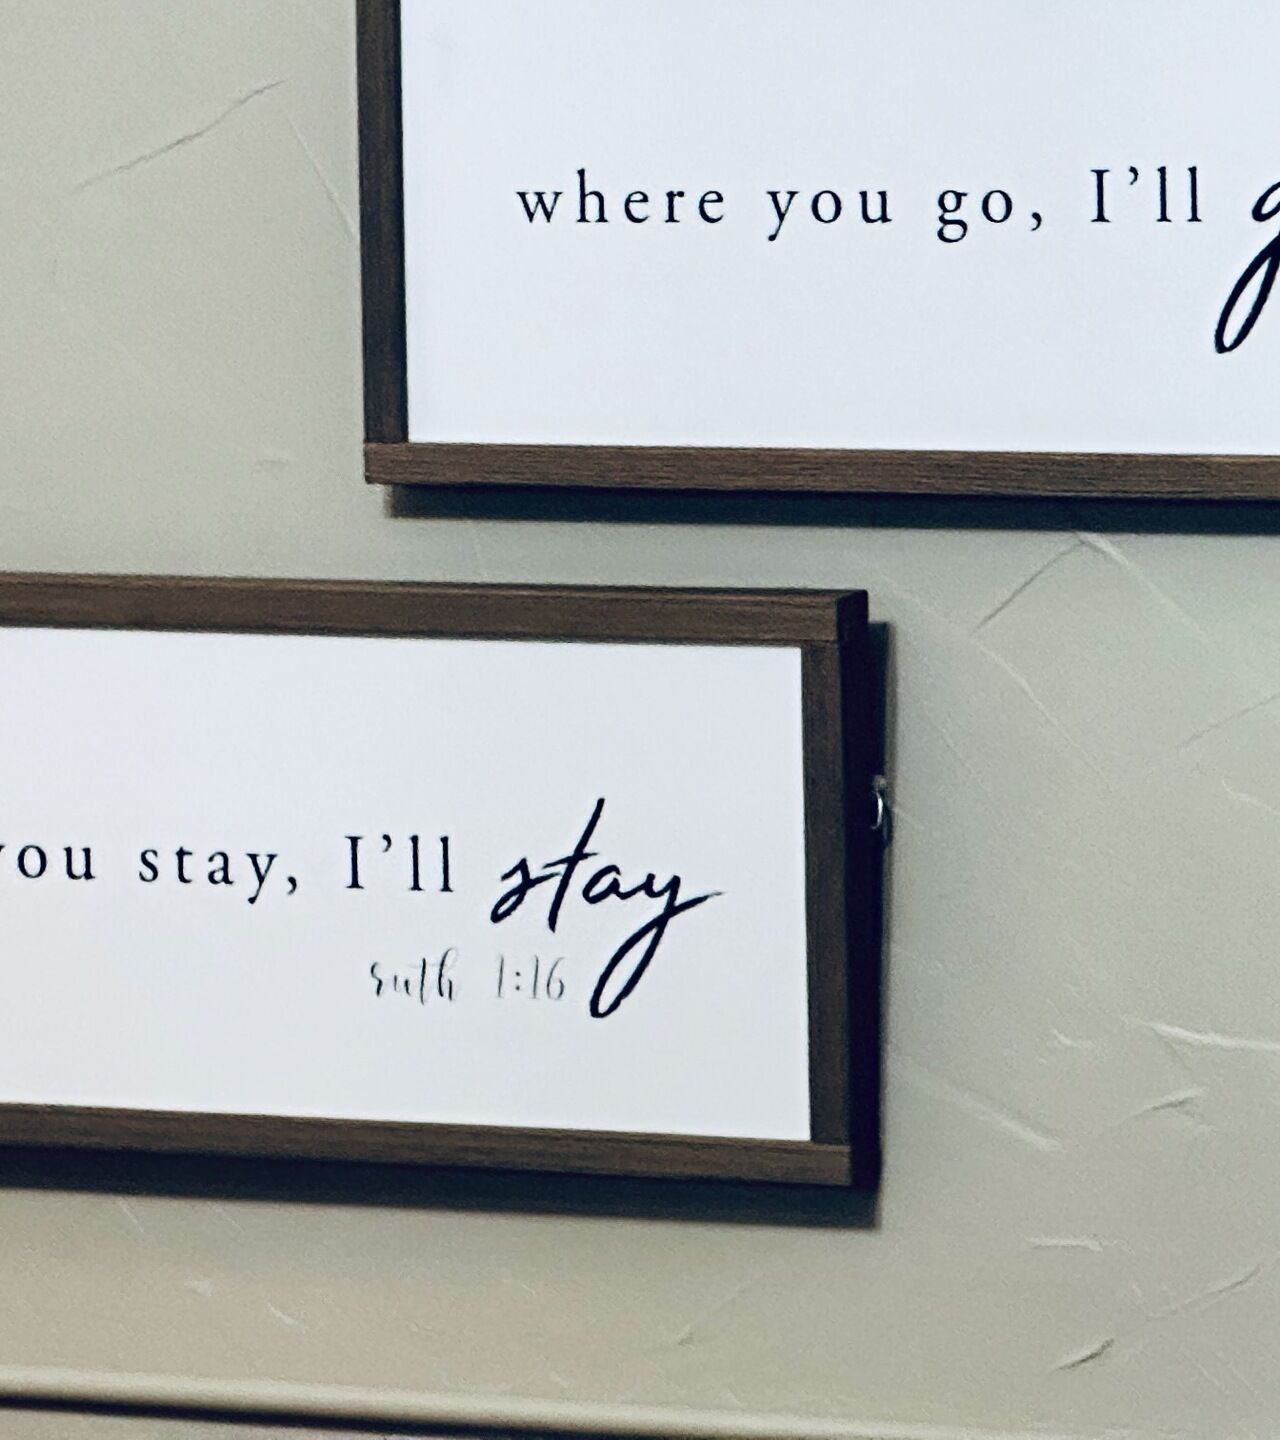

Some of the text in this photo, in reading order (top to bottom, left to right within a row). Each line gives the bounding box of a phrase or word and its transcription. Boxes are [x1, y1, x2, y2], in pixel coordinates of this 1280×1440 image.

[515, 167, 725, 225] where
[766, 189, 894, 243] you
[935, 188, 1045, 244] go,
[1090, 165, 1204, 224] I’ll
[137, 845, 299, 905] stay,
[344, 833, 455, 894] I’ll
[489, 797, 724, 1019] stay
[493, 954, 567, 1001] 1:16
